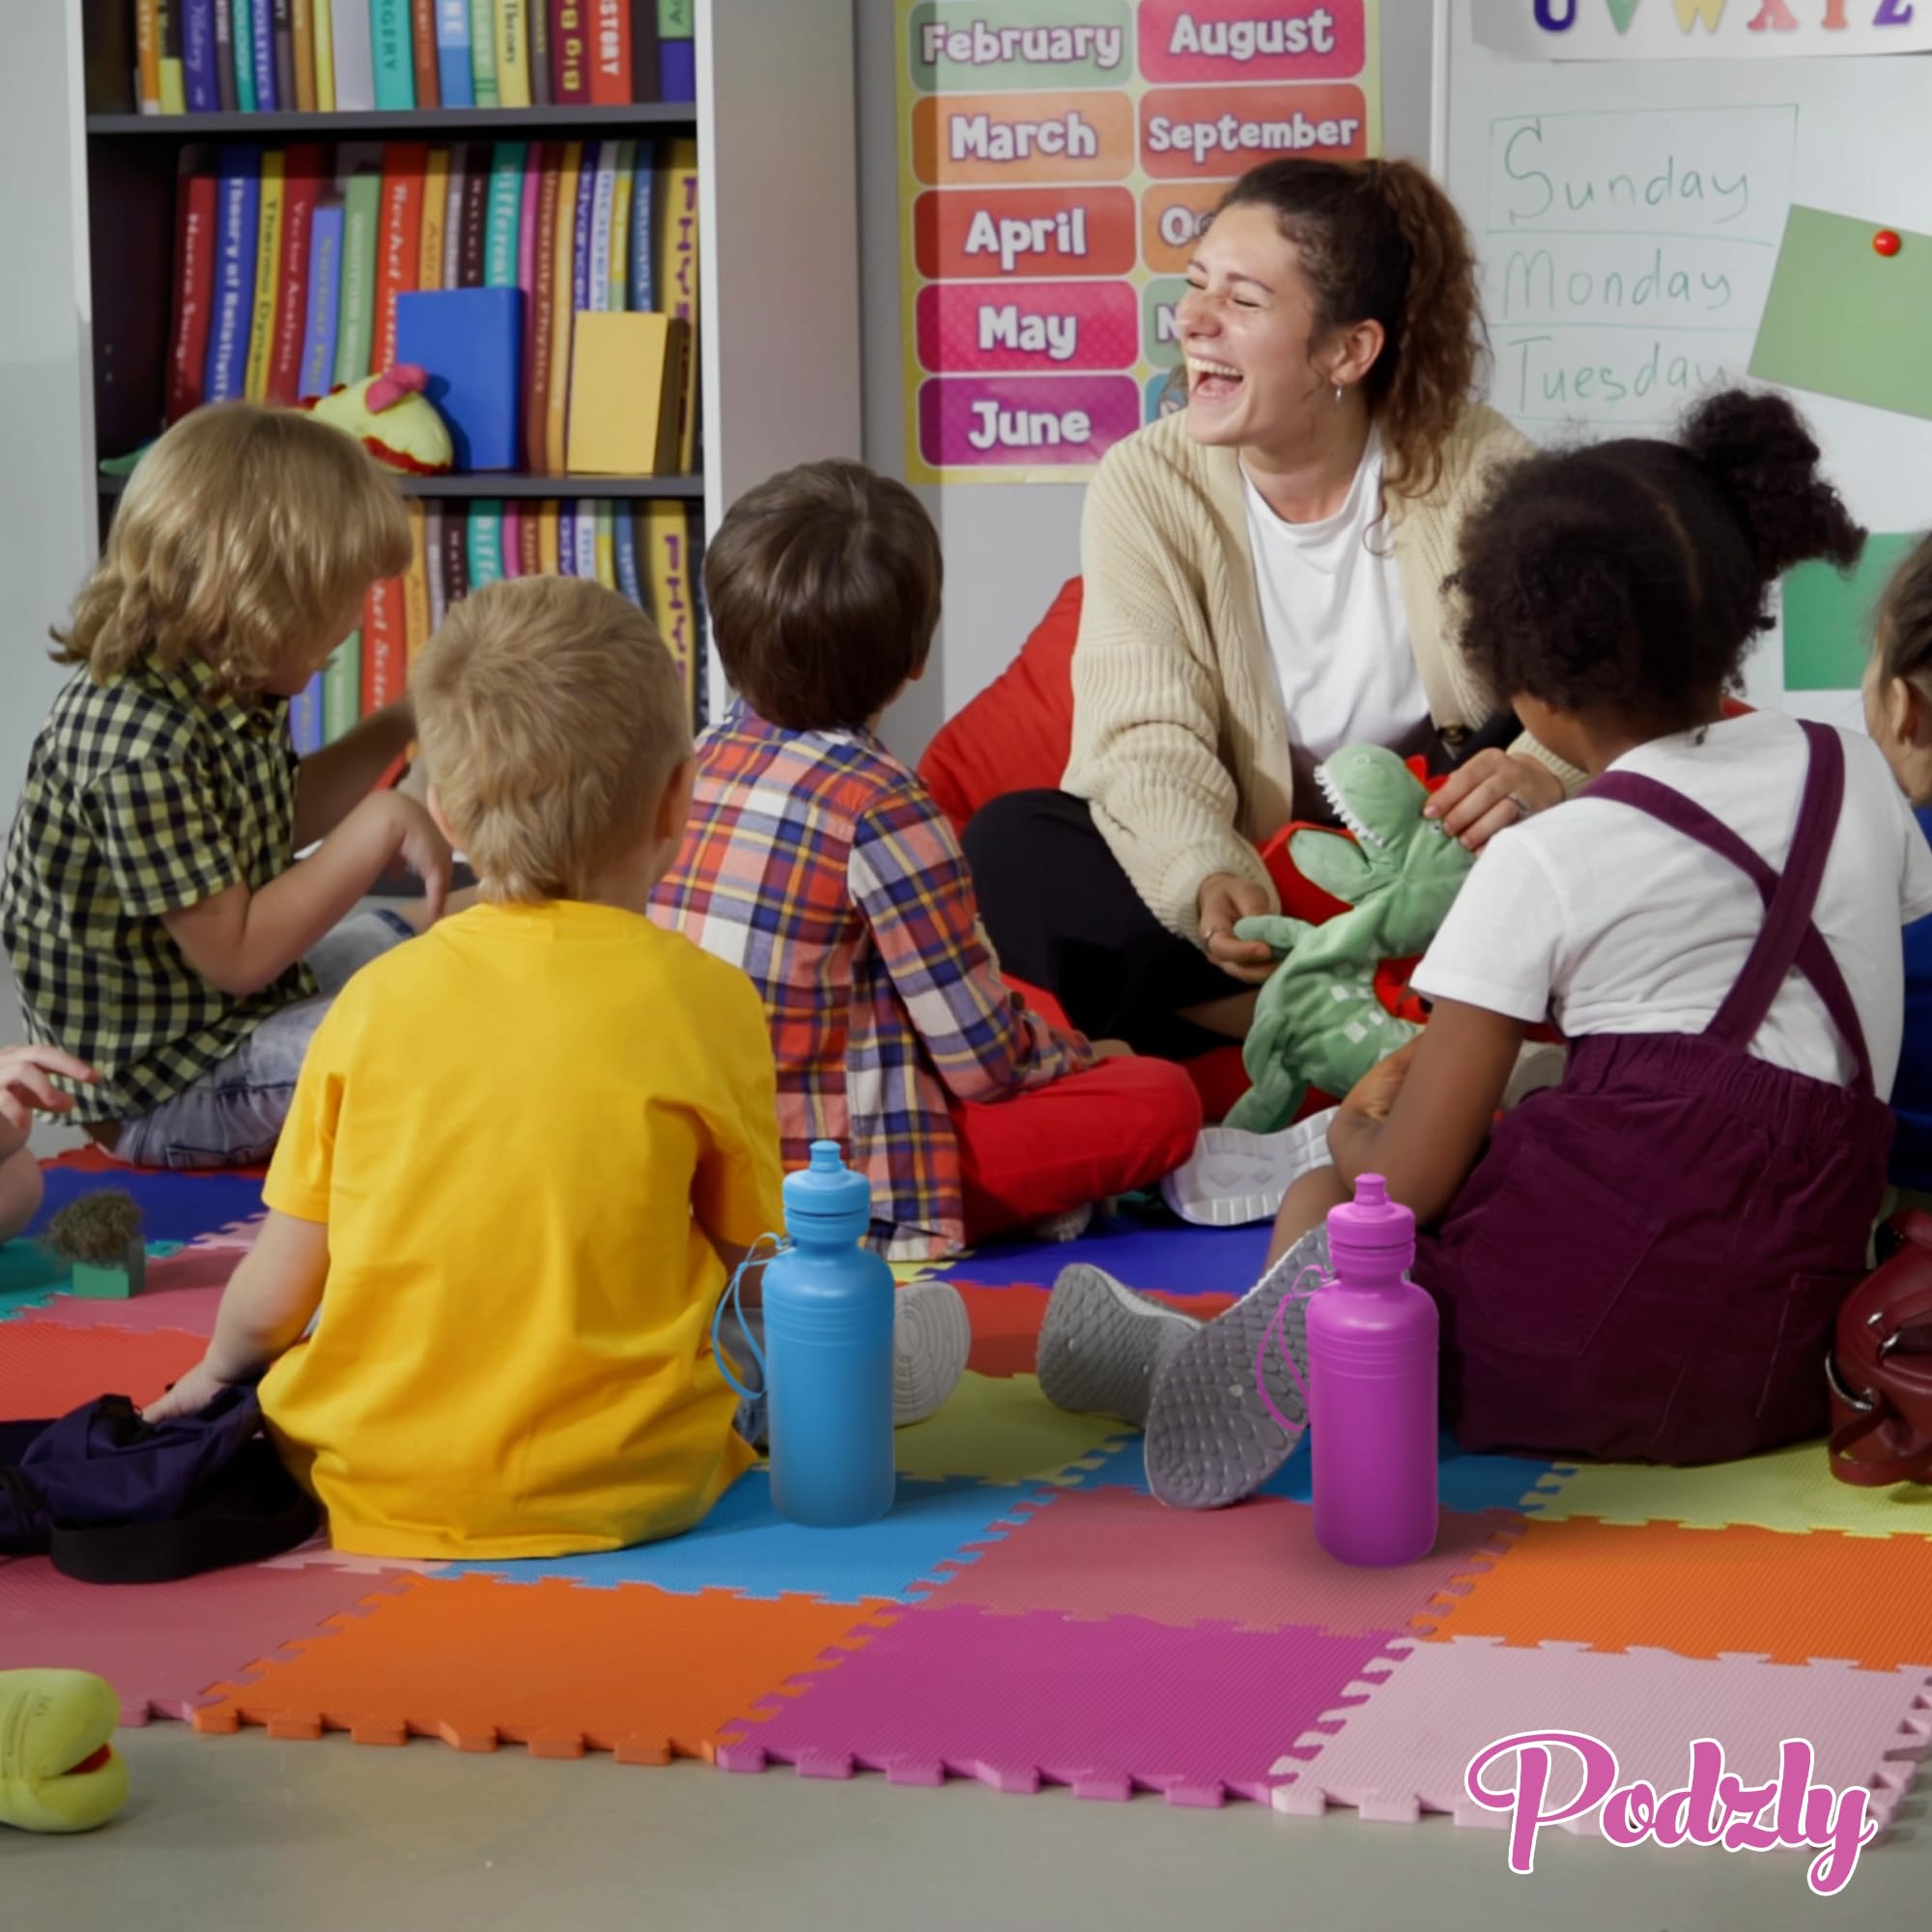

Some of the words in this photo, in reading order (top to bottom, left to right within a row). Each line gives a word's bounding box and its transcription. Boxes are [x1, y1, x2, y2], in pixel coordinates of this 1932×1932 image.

[598, 0, 620, 77] STORY
[923, 19, 1123, 69] February
[1168, 9, 1336, 62] August
[949, 112, 1099, 162] March
[1148, 113, 1359, 163] September
[1504, 116, 1748, 226] Sunday
[963, 207, 1088, 271] April
[1503, 248, 1732, 318] Monday
[279, 280, 300, 373] Analysis
[978, 305, 1077, 360] May
[1508, 335, 1730, 413] Tuesday
[968, 399, 1092, 449] June
